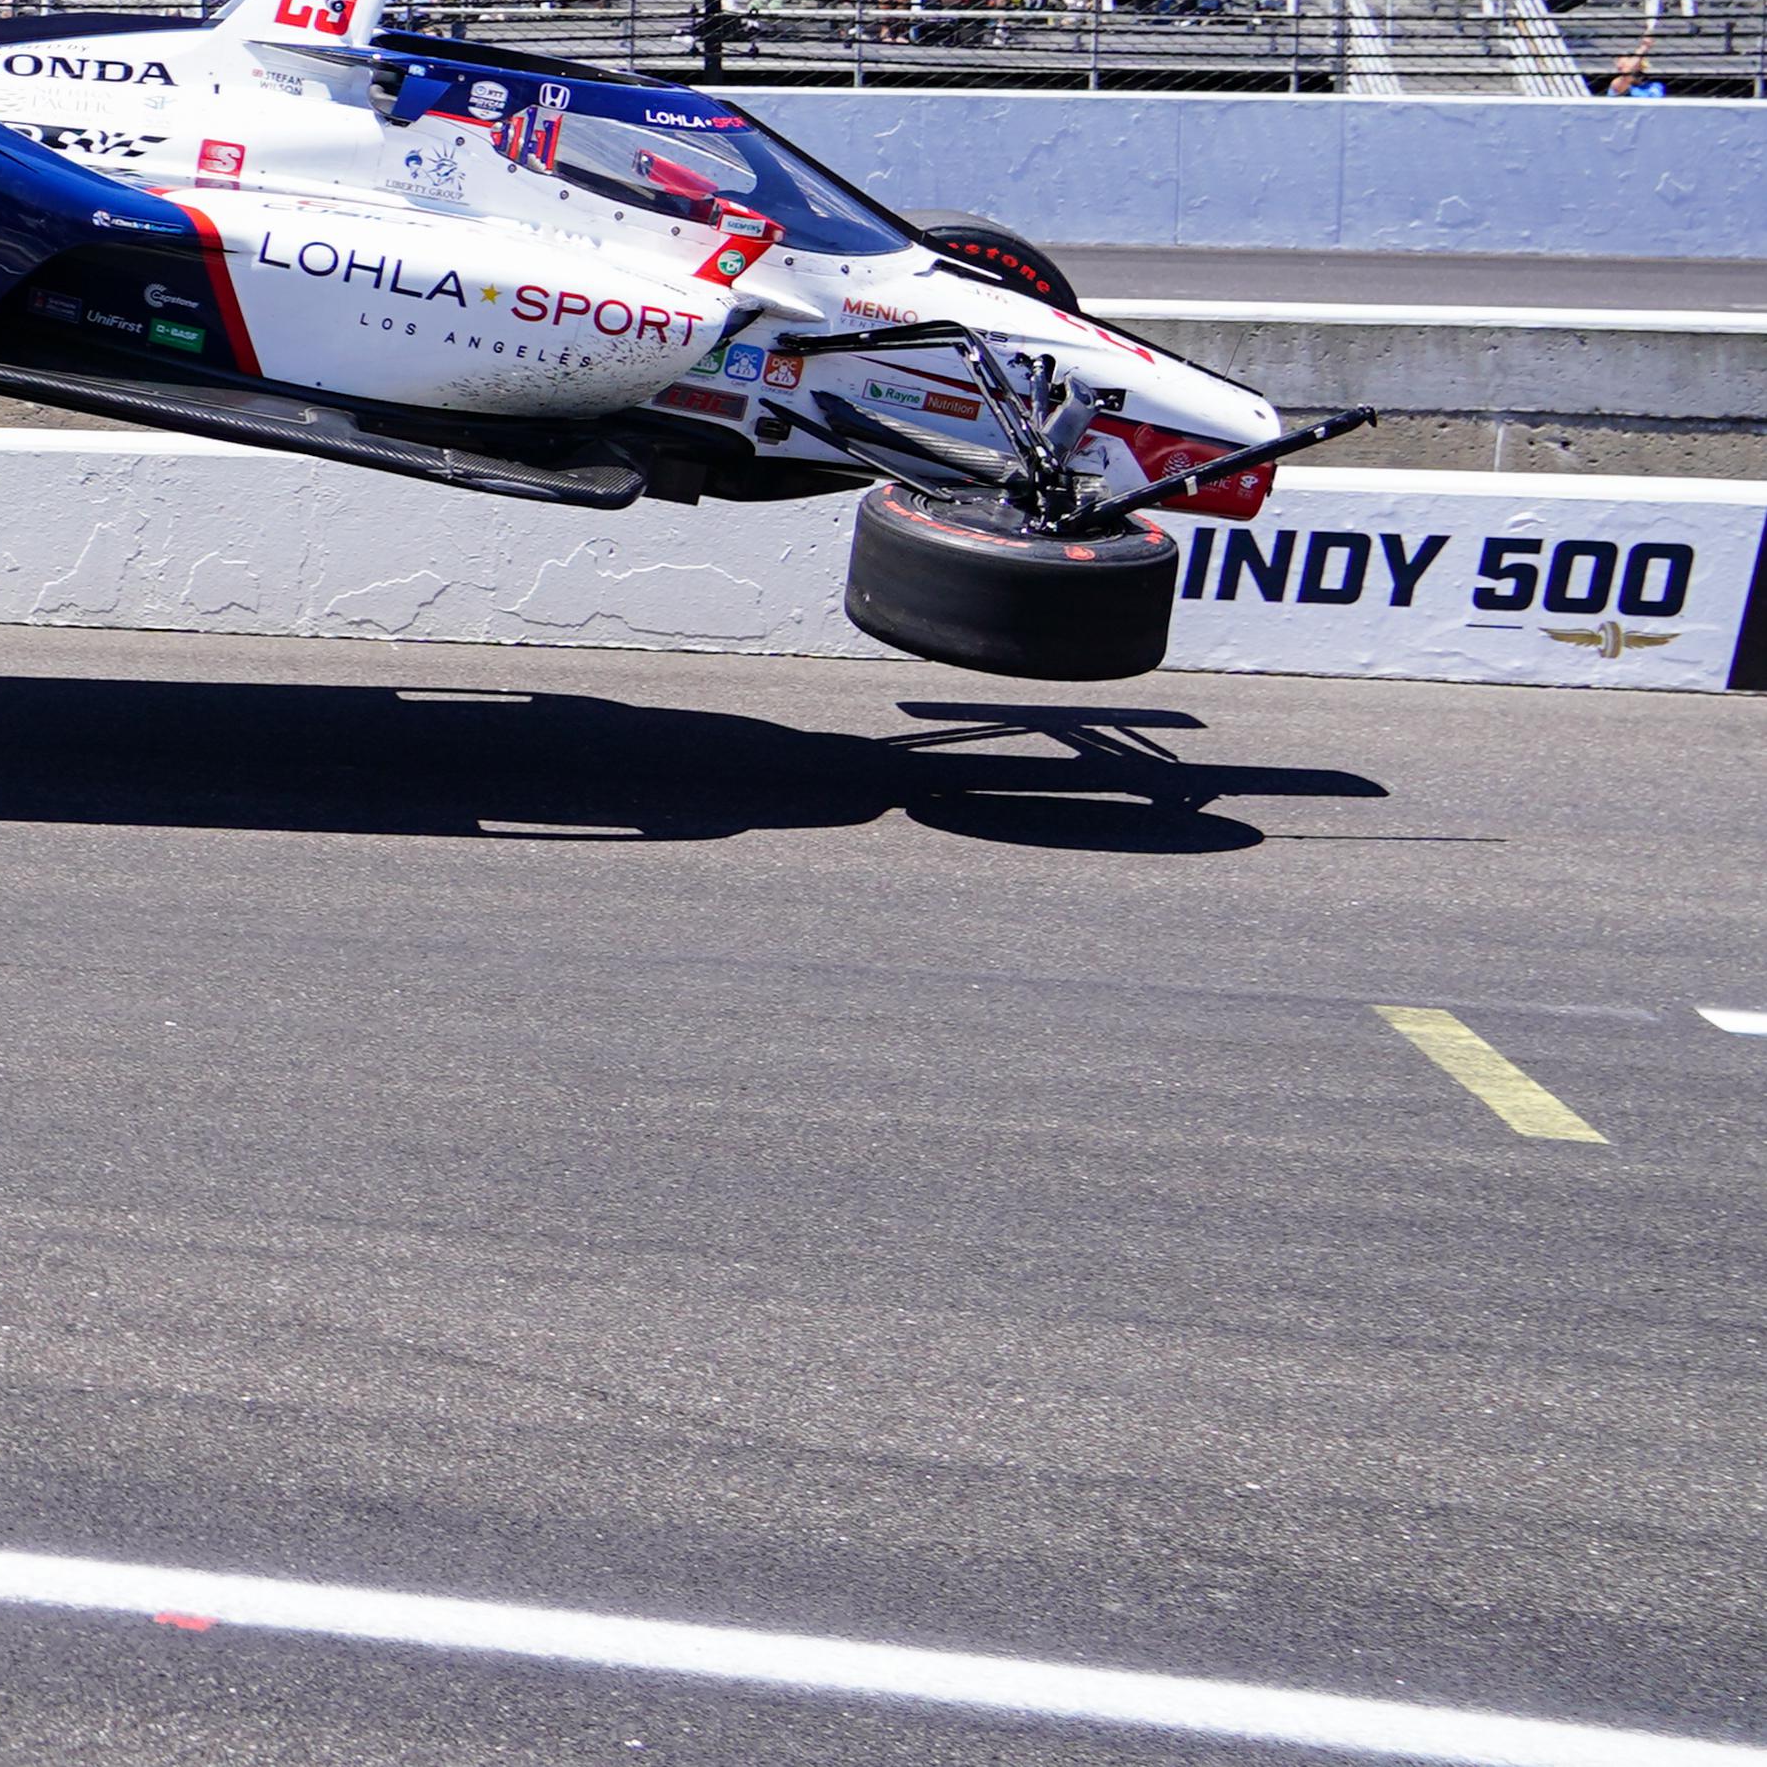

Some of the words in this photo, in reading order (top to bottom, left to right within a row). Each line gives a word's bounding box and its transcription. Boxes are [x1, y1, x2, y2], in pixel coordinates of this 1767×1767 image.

[265, 71, 304, 87] STEFAN
[645, 109, 706, 128] LOHLA
[385, 178, 427, 195] LIBERTY
[429, 185, 465, 201] GROUP
[258, 231, 467, 308] LOHLA
[510, 284, 703, 347] SPORT
[86, 308, 144, 334] UniFirst
[842, 296, 918, 325] MENLO
[359, 312, 418, 336] LOS
[443, 331, 592, 368] ANGELES
[884, 386, 921, 405] Rayne
[927, 396, 976, 416] Nutrition
[1180, 526, 1452, 608] INDY
[1471, 536, 1696, 617] 500
